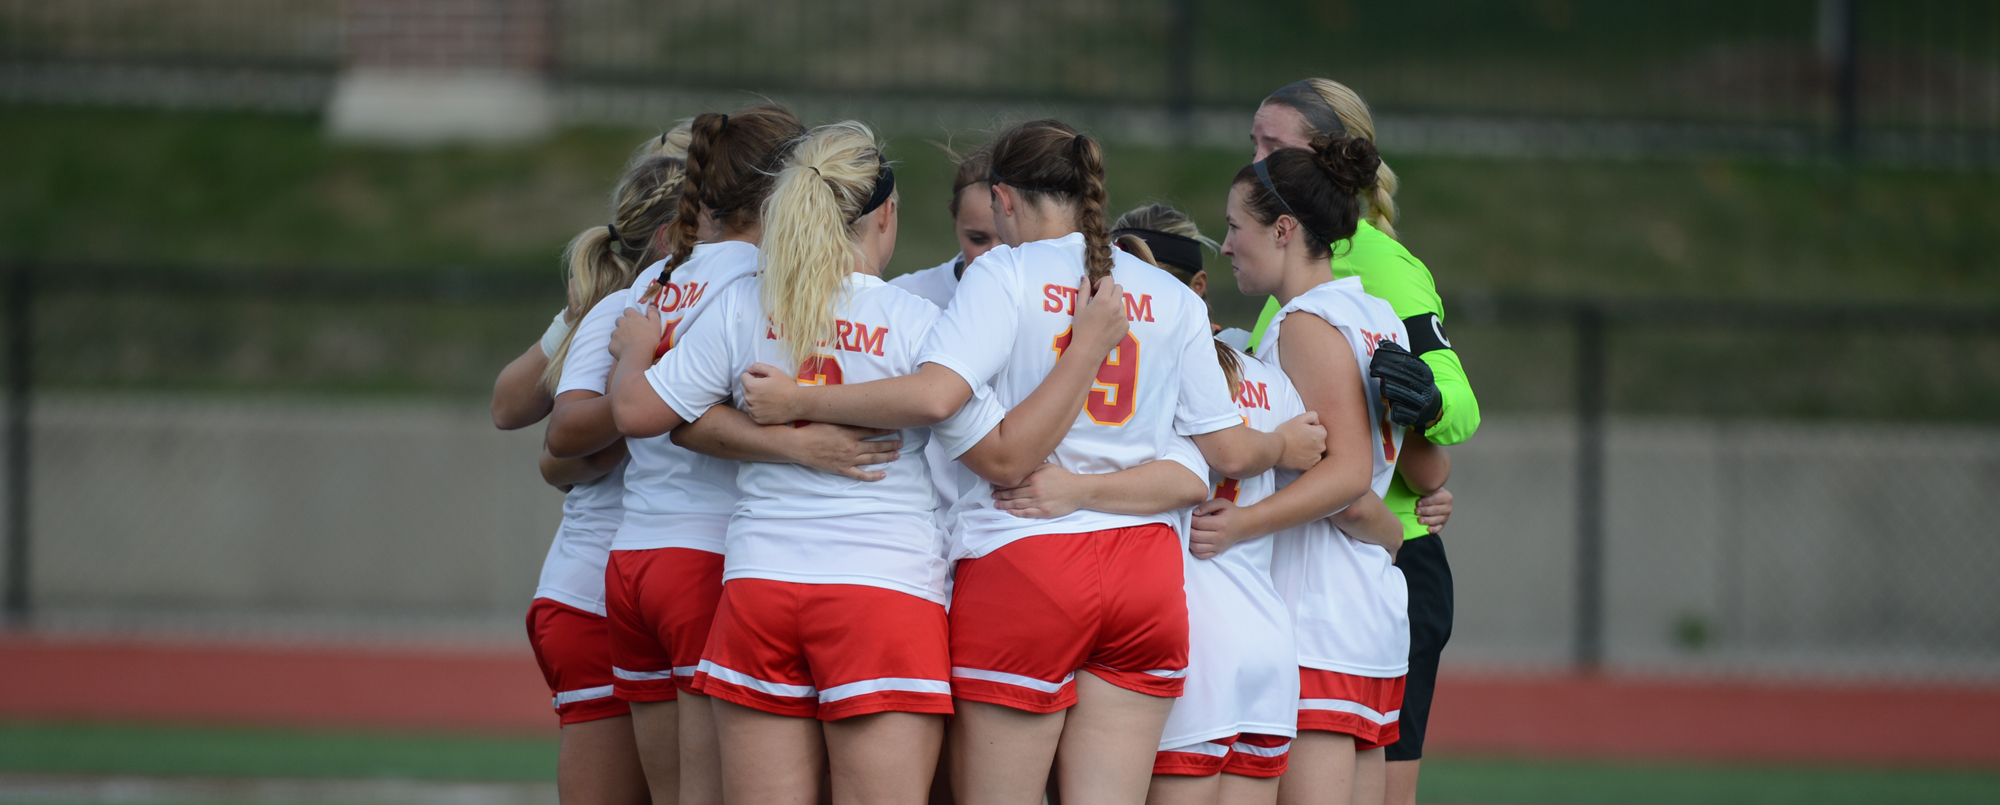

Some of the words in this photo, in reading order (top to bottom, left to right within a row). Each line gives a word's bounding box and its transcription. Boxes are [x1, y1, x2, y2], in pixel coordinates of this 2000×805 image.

[1043, 283, 1155, 322] STM
[766, 310, 889, 357] SRM
[1431, 314, 1452, 348] C
